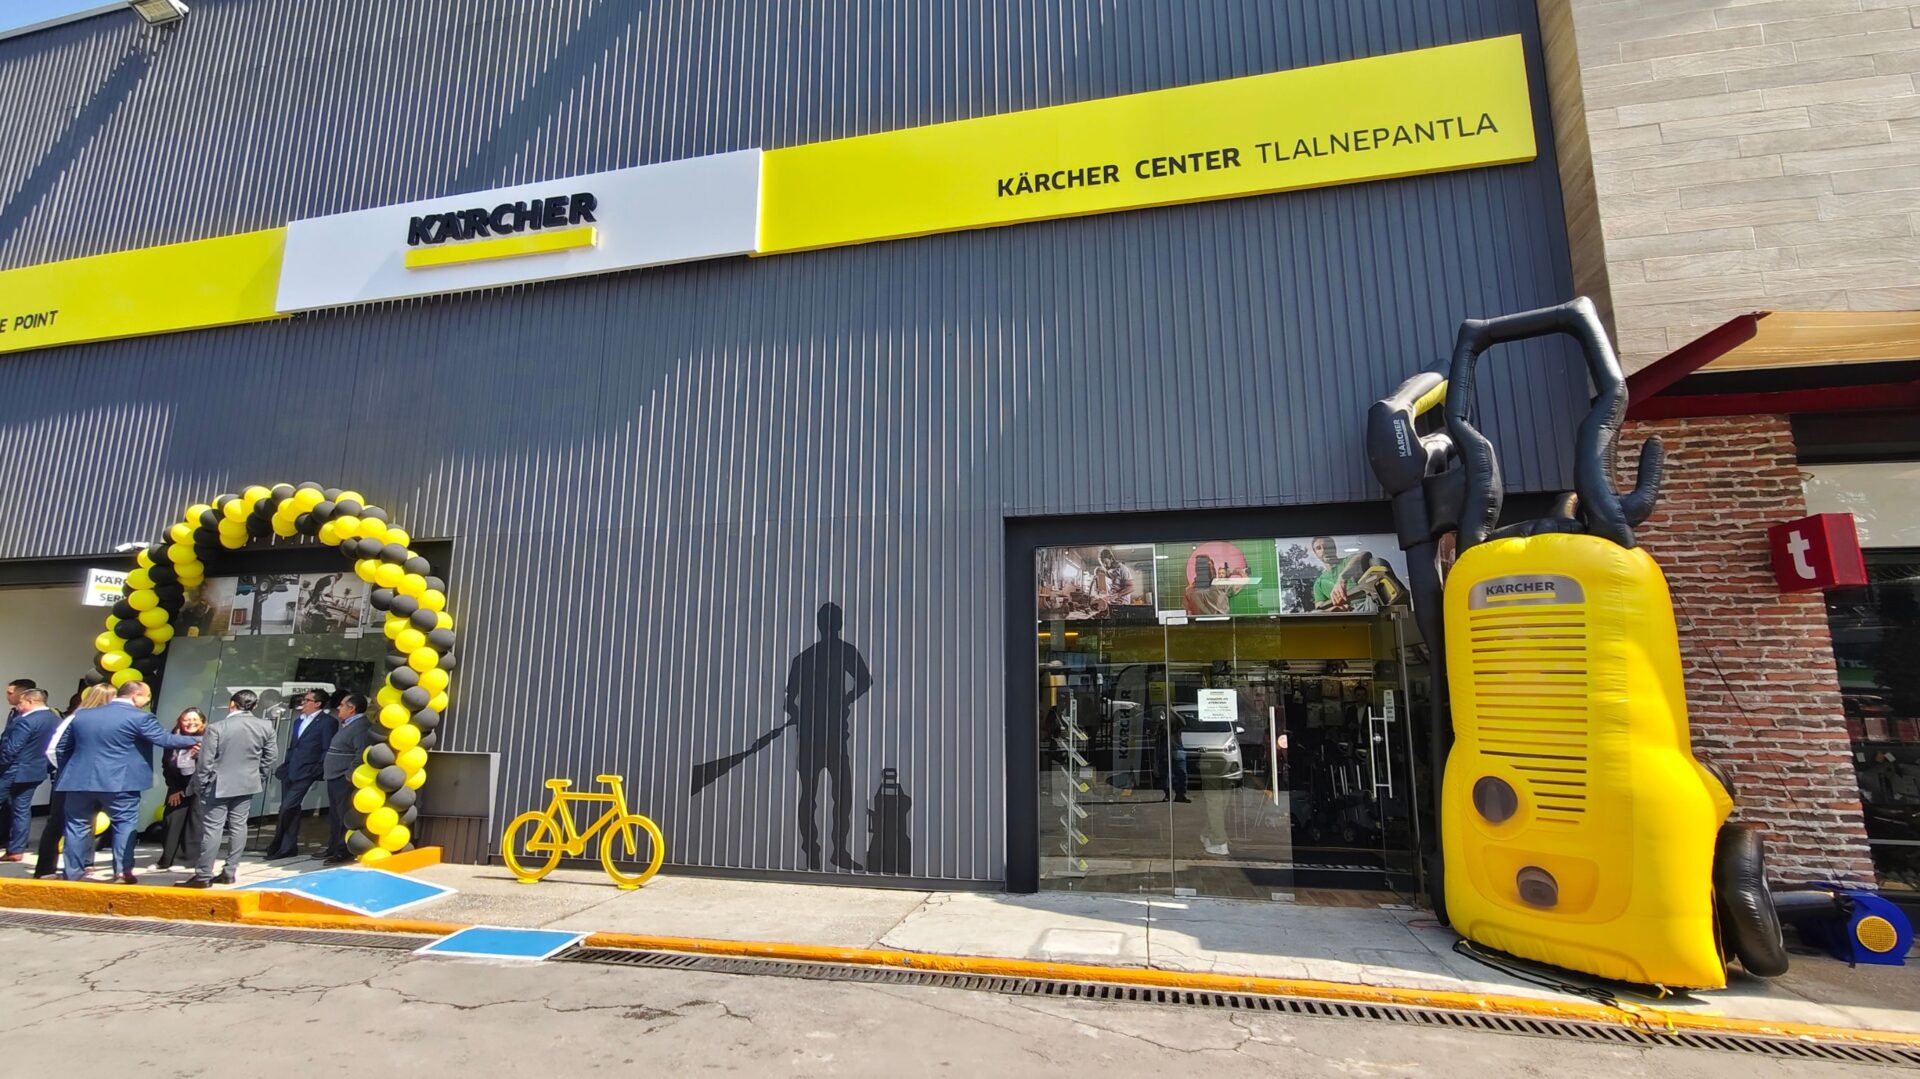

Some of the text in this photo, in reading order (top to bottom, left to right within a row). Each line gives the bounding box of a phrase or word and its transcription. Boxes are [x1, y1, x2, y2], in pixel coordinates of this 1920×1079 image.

[998, 112, 1498, 198] KÄRCHER CENTER TLALNEPANTLA
[407, 192, 598, 246] KÄRCHER
[13, 309, 59, 332] POINT
[1486, 581, 1555, 596] KÄRCHER
